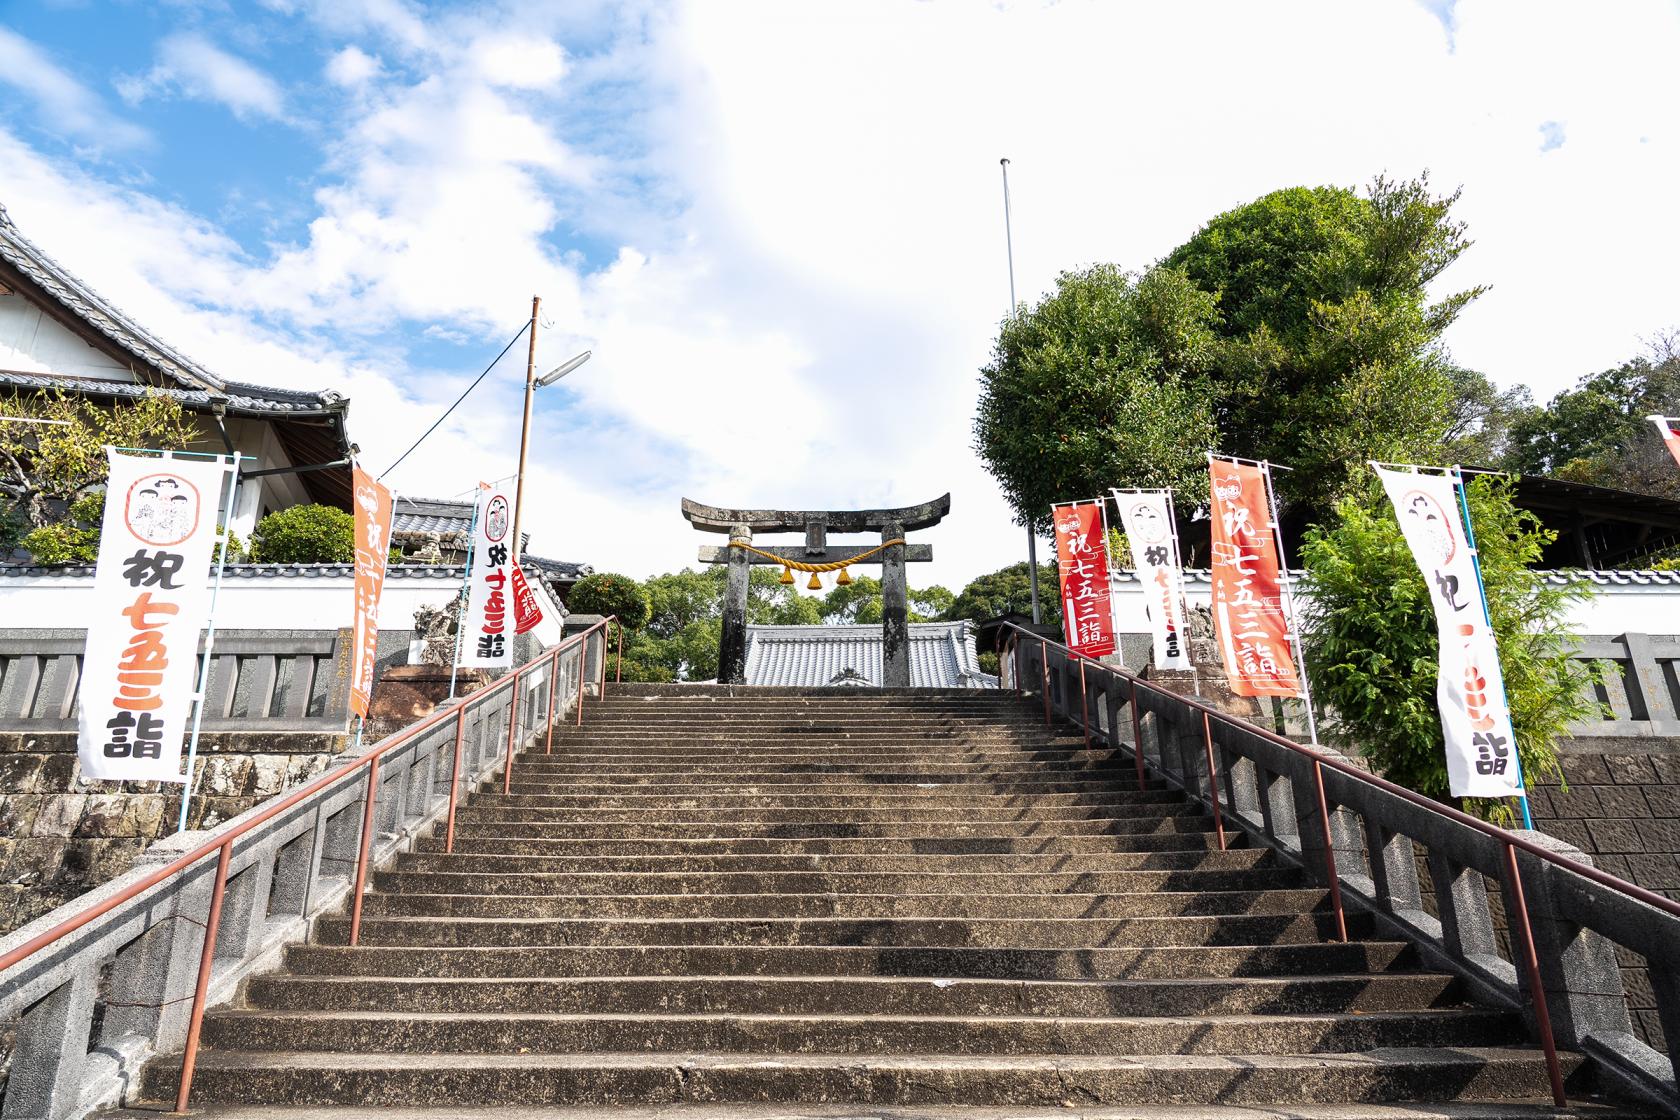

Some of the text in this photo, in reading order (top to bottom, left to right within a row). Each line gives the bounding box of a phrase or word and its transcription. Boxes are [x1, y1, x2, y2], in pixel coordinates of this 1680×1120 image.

[102, 549, 185, 760] 祝七五三詣
[1067, 532, 1101, 644] 祝七五三詣
[1223, 500, 1277, 675] 祝七五三詣
[1435, 569, 1508, 775] 祝三詣
